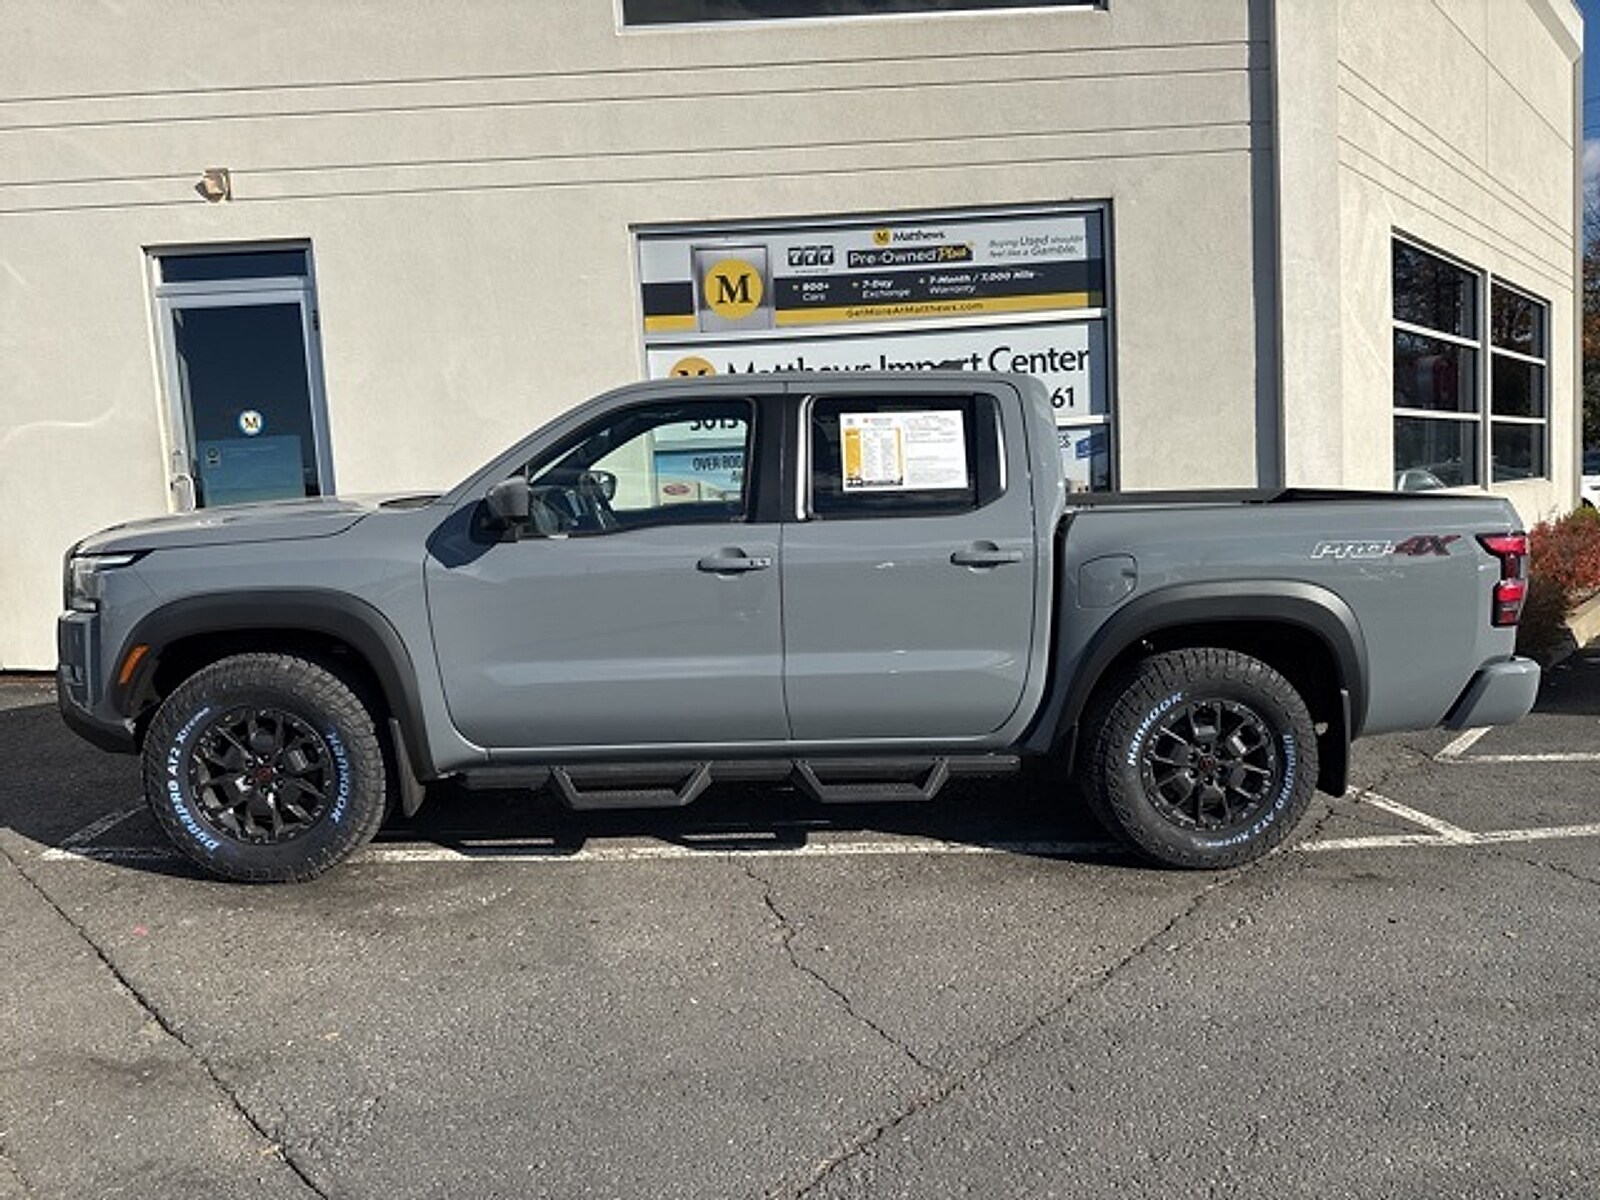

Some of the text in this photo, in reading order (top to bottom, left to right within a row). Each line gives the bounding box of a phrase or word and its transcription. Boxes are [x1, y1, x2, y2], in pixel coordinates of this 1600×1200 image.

[892, 230, 946, 241] Matthews
[1020, 235, 1049, 246] Used
[849, 249, 937, 266] Pre-Owned
[715, 273, 753, 304] M
[988, 346, 1090, 373] Center
[1127, 692, 1182, 767] HANKOOK
[167, 747, 181, 776] AT2
